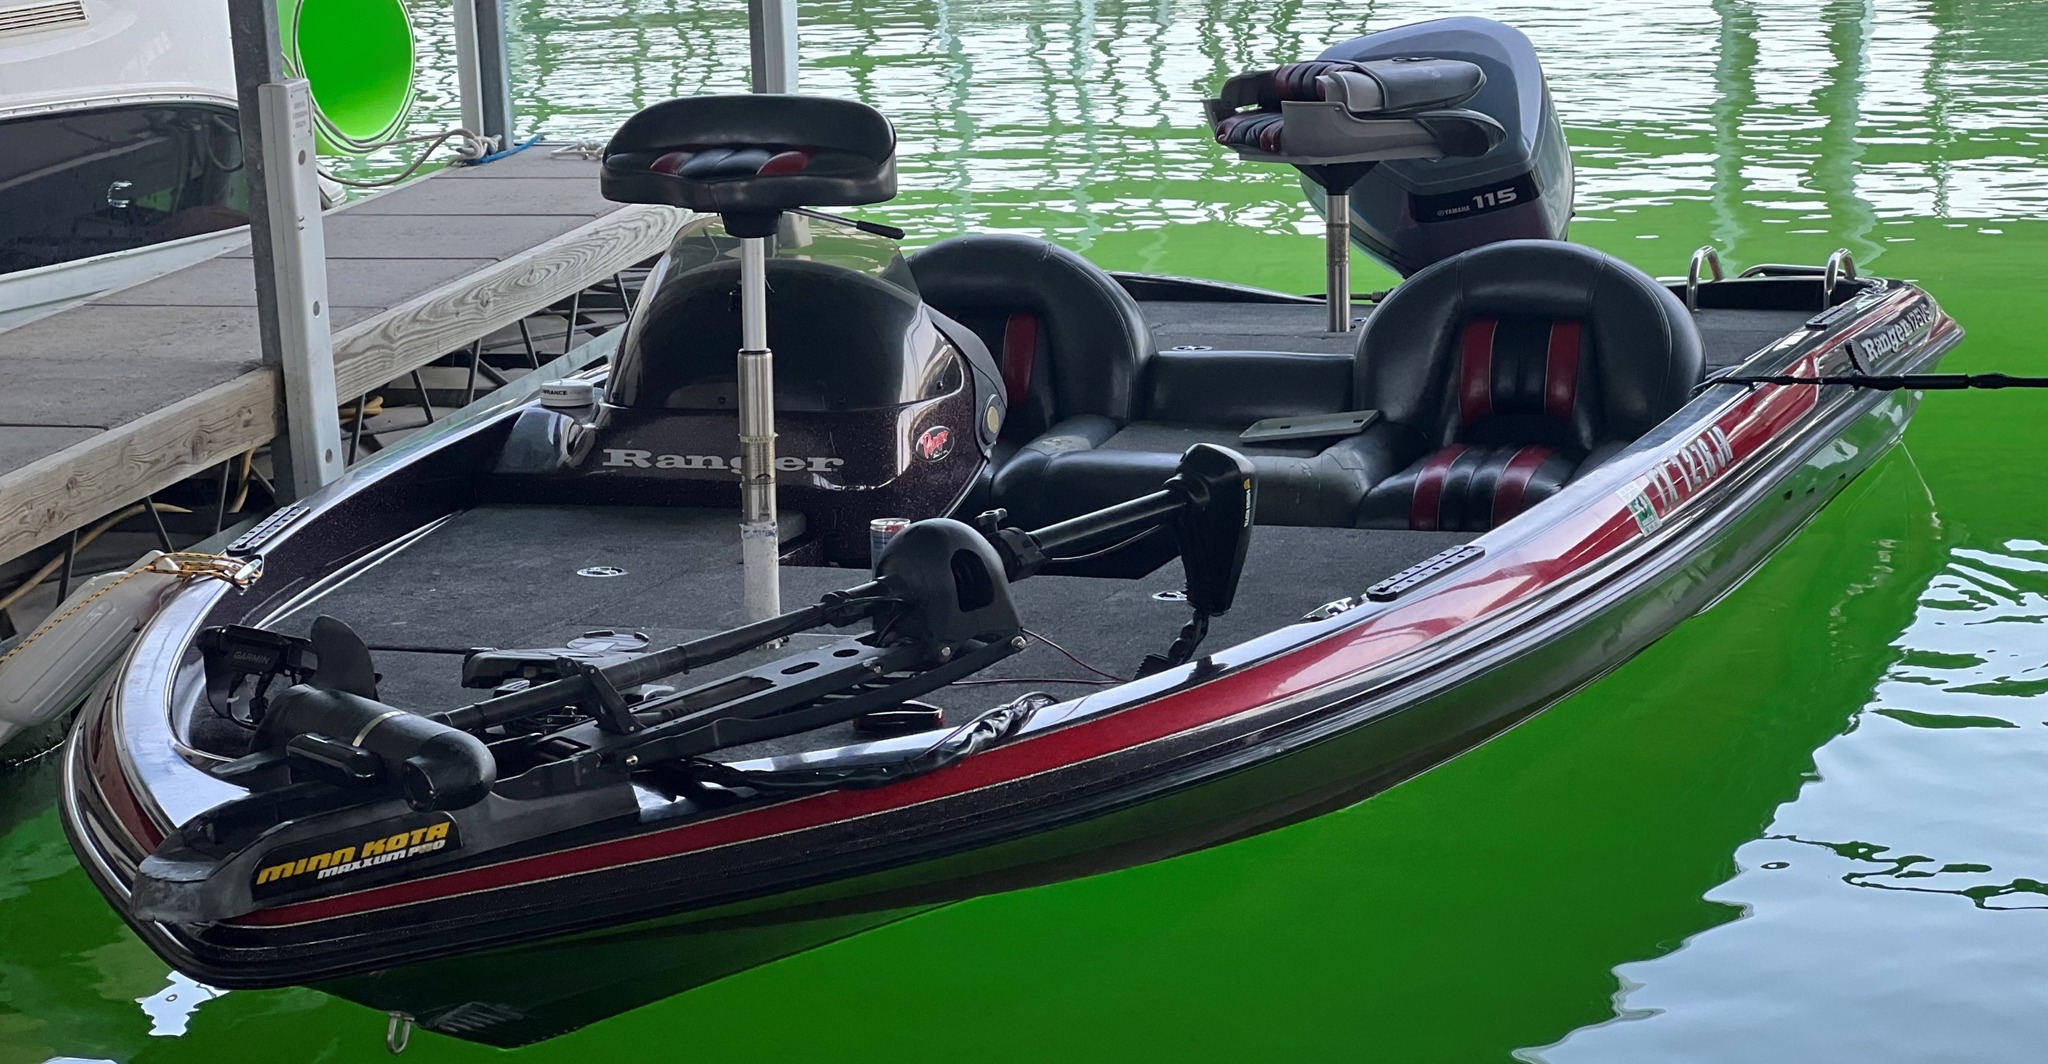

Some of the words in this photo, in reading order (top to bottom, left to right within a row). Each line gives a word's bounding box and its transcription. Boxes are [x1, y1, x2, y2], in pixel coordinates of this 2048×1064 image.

[1443, 205, 1471, 215] YAMAHA
[1472, 187, 1517, 209] 115
[1861, 318, 1911, 361] Ranger
[1645, 461, 1679, 511] TX
[233, 651, 270, 664] GARMIN
[255, 846, 357, 885] MINN
[361, 821, 451, 859] KOTA
[316, 849, 406, 880] MAXXUM
[407, 839, 447, 858] PRO
